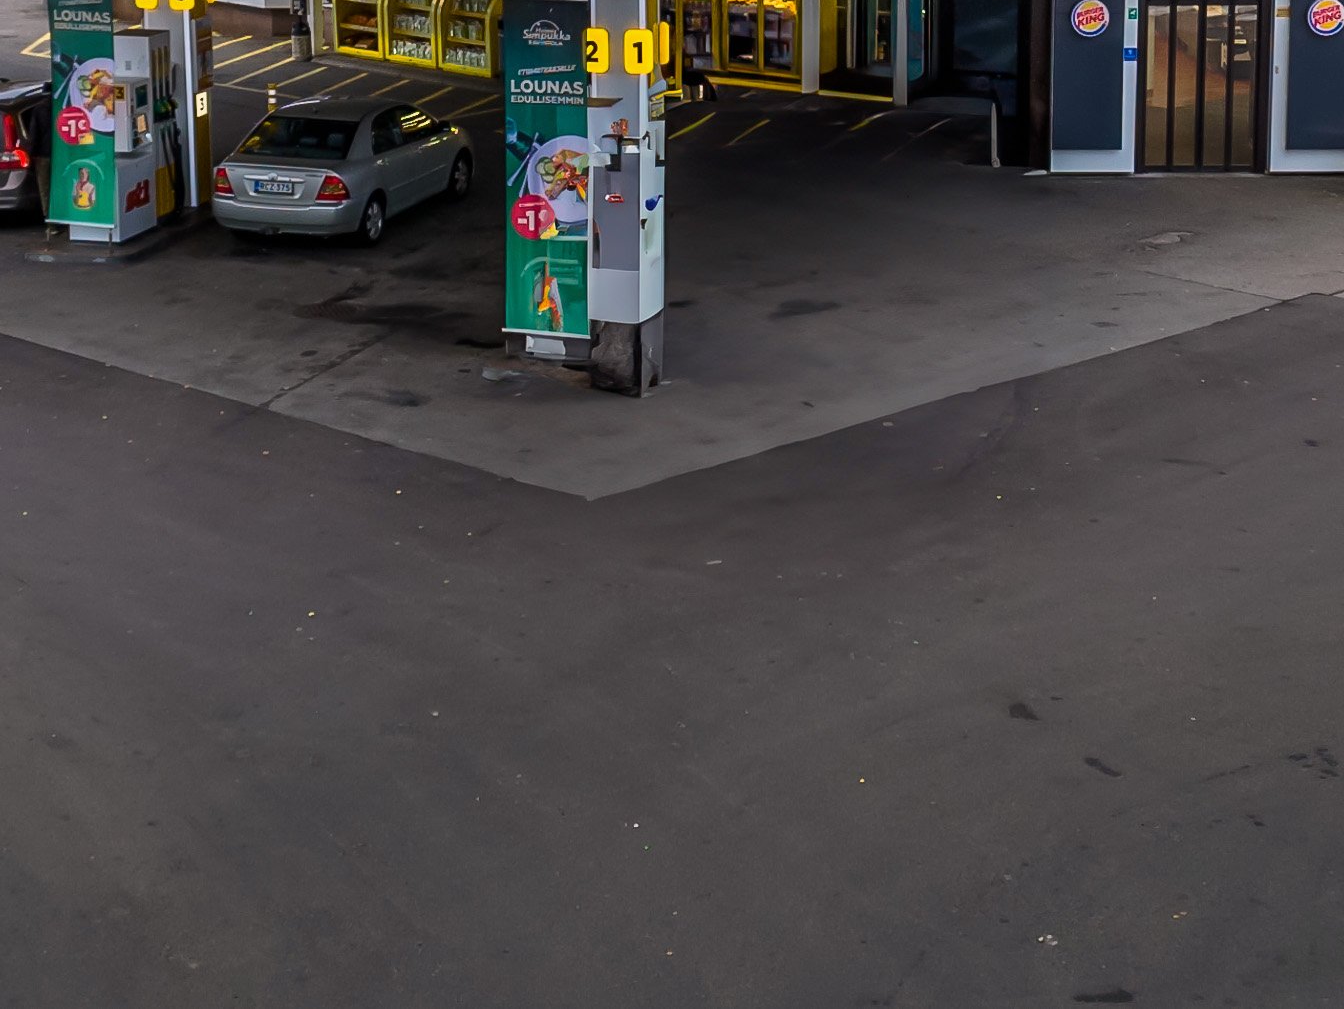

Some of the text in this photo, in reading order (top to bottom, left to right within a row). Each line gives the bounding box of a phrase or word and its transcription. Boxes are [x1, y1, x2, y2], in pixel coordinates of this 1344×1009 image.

[53, 9, 111, 24] LOUNAS
[1077, 12, 1105, 28] KING
[1313, 11, 1342, 27] KING
[585, 40, 643, 64] 2 1
[510, 79, 584, 95] LOUNAS
[510, 95, 584, 105] EDULLISEMMIN
